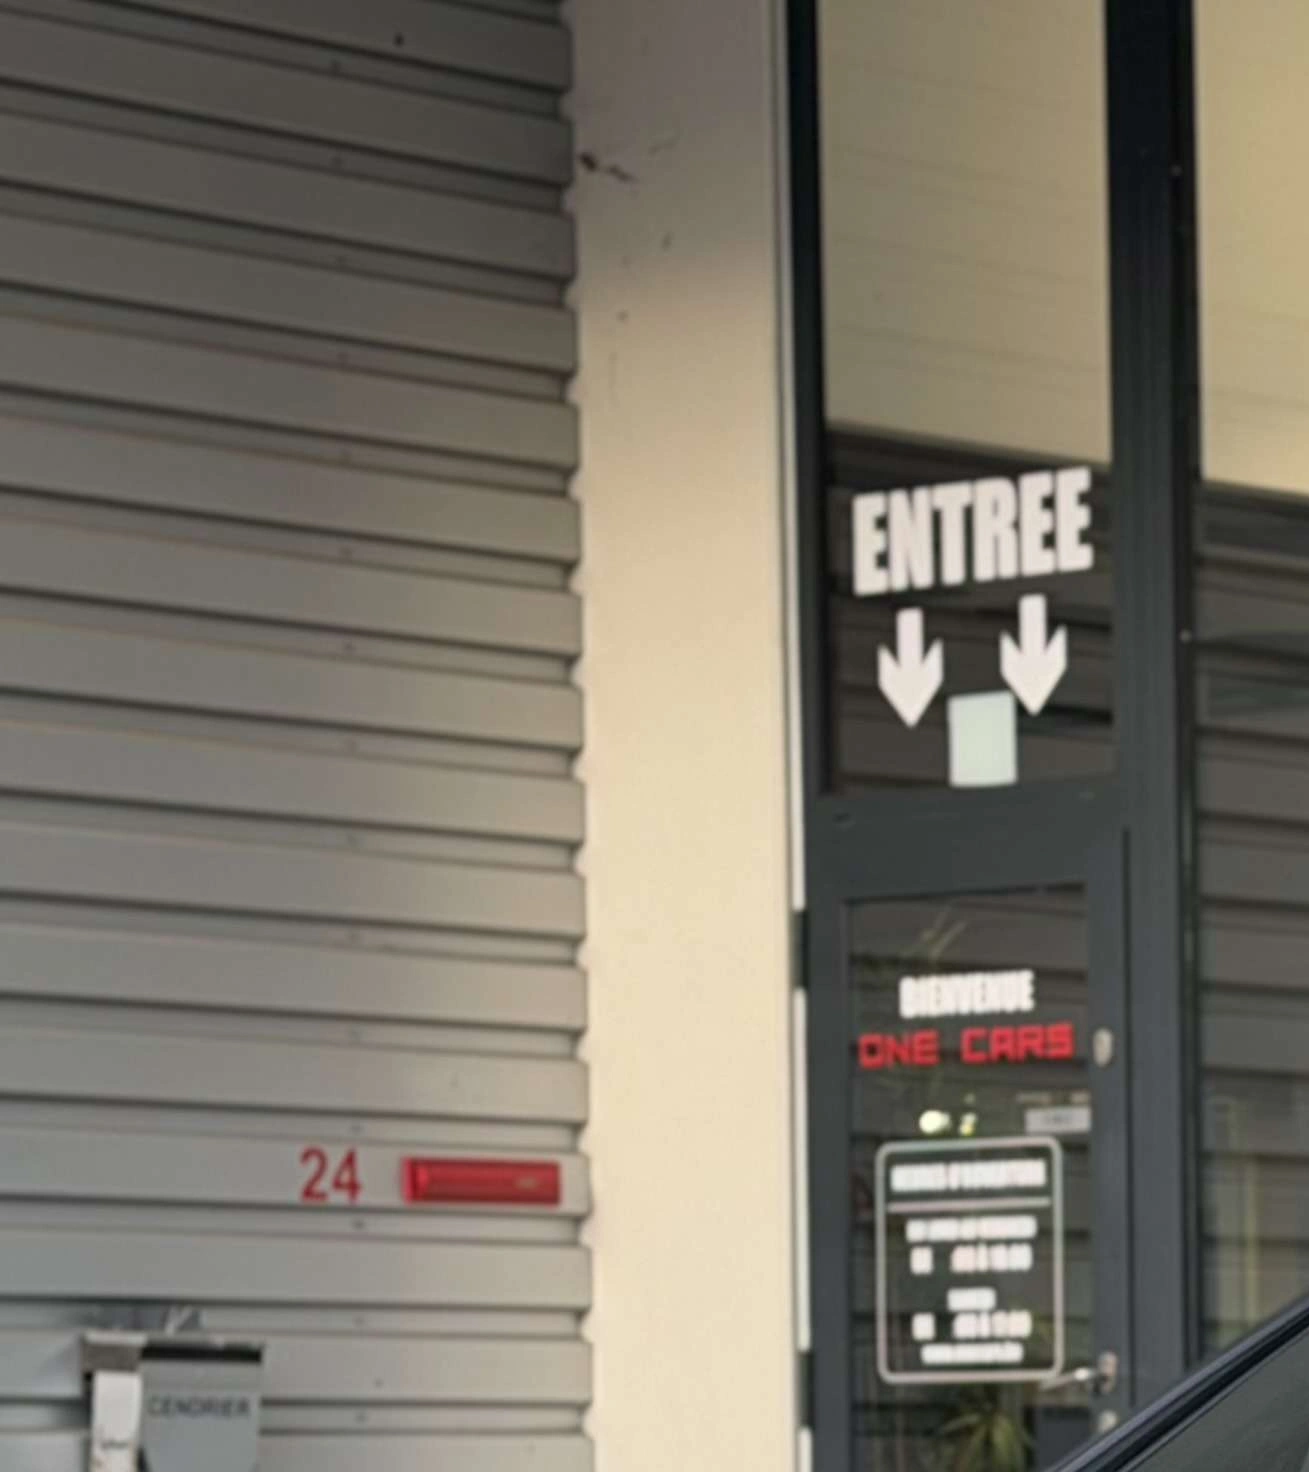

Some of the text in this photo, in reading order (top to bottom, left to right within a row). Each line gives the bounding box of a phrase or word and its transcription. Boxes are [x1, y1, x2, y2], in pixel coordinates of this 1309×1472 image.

[852, 465, 1094, 597] ENTREE
[858, 1021, 1076, 1070] ONE CARS
[300, 1147, 362, 1203] 24
